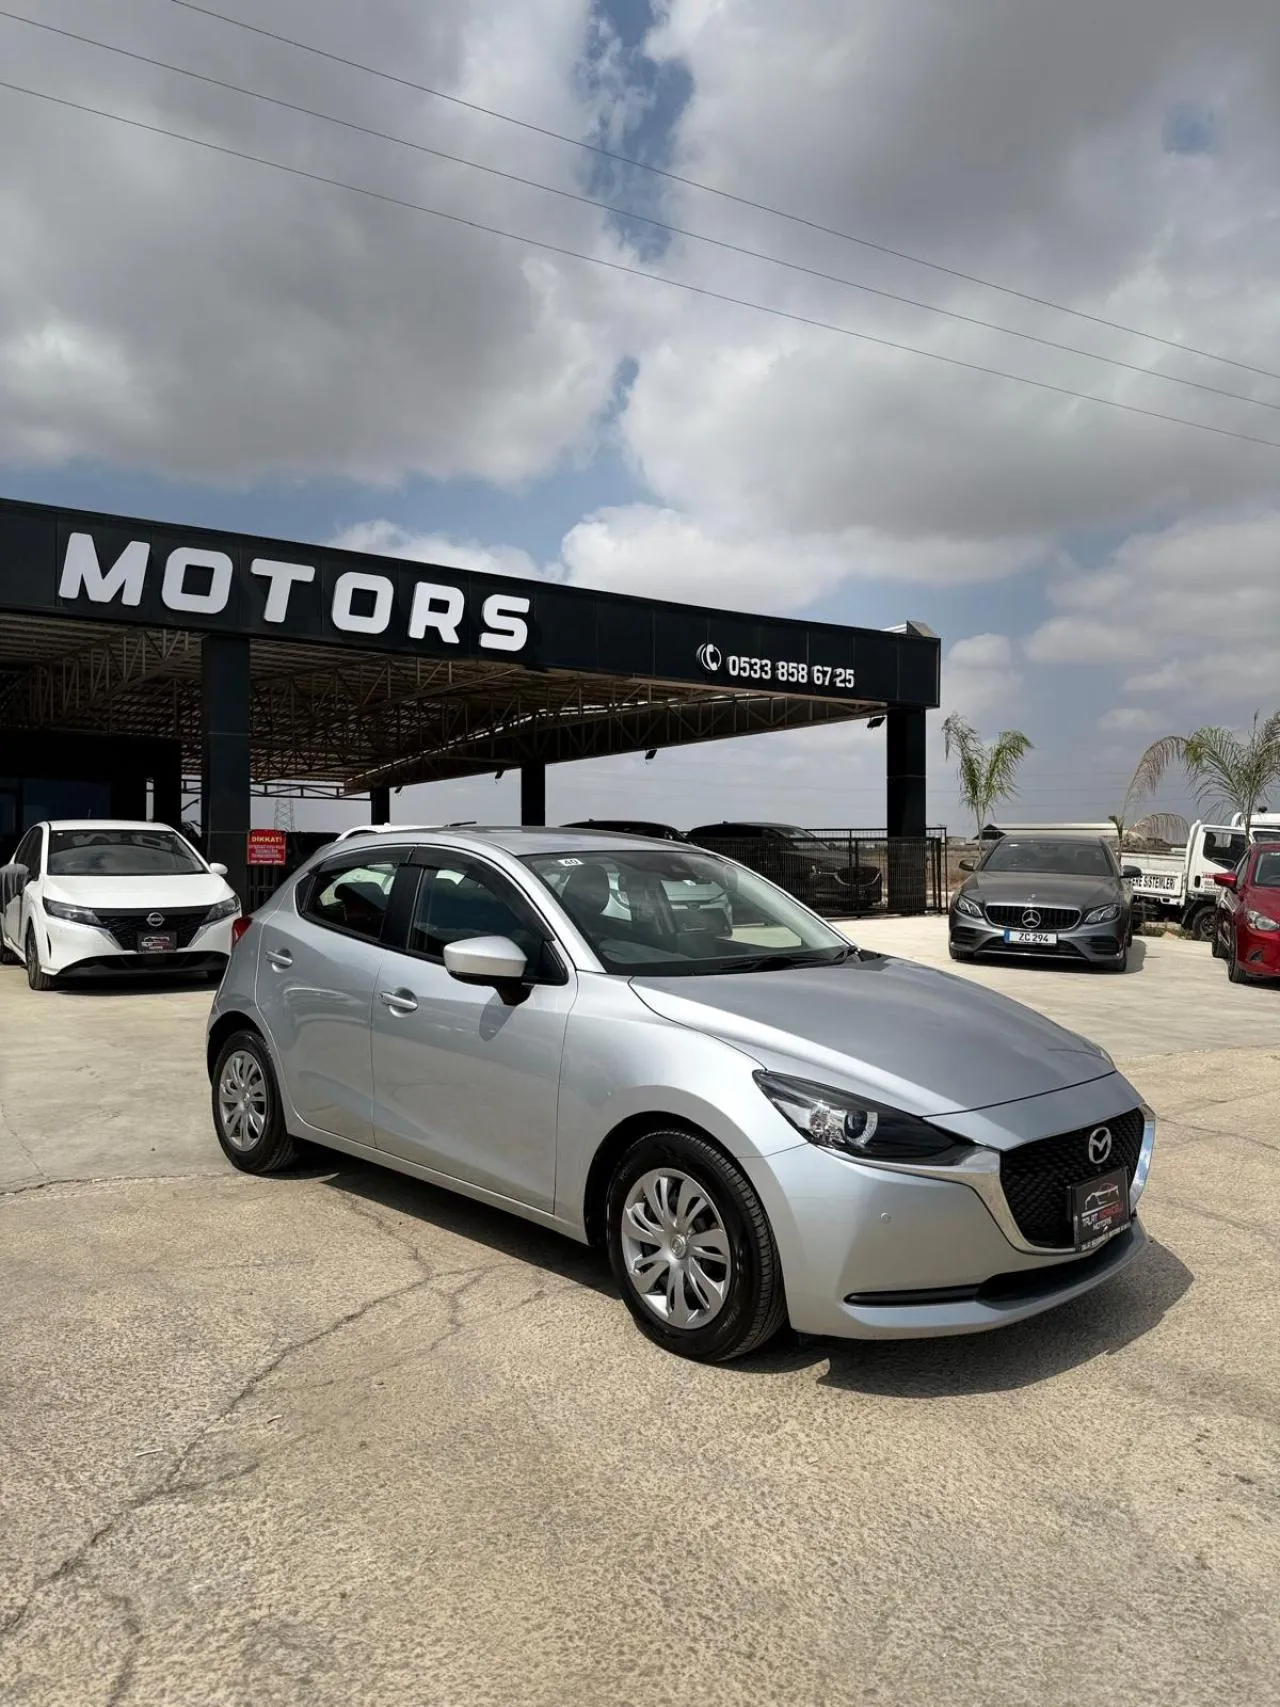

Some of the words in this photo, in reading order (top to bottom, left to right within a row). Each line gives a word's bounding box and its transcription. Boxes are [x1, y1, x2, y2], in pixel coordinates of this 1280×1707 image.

[59, 533, 530, 652] MOTORS
[728, 656, 772, 680] 0533
[776, 661, 808, 684] 858
[1019, 932, 1030, 941] ZC
[1032, 934, 1048, 942] 294
